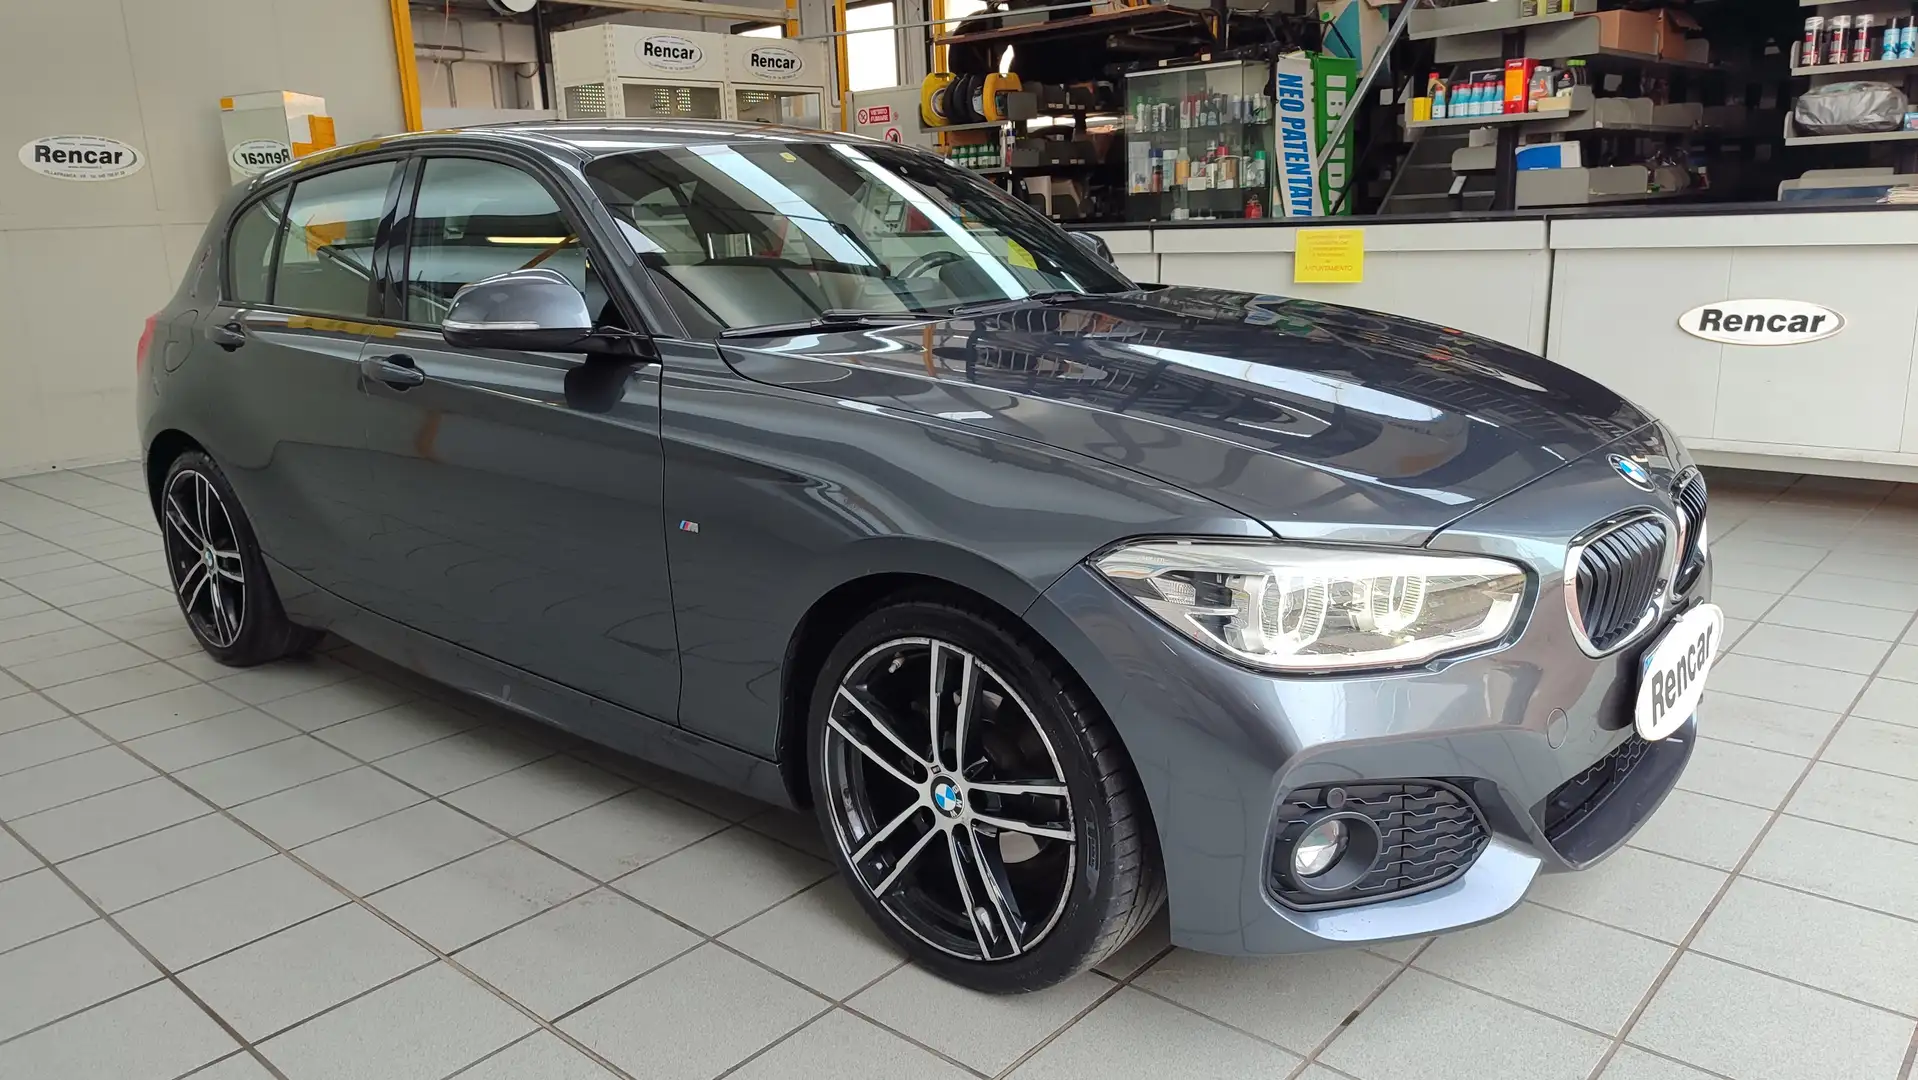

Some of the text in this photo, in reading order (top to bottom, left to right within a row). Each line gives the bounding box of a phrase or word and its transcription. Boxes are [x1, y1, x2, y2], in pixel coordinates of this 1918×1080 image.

[644, 42, 695, 59] Rencar
[751, 53, 795, 69] Rencar
[35, 145, 123, 164] Rencar
[1278, 73, 1313, 216] NEO PATENTATI
[1699, 309, 1826, 333] Rencar
[1652, 622, 1713, 728] Rencar
